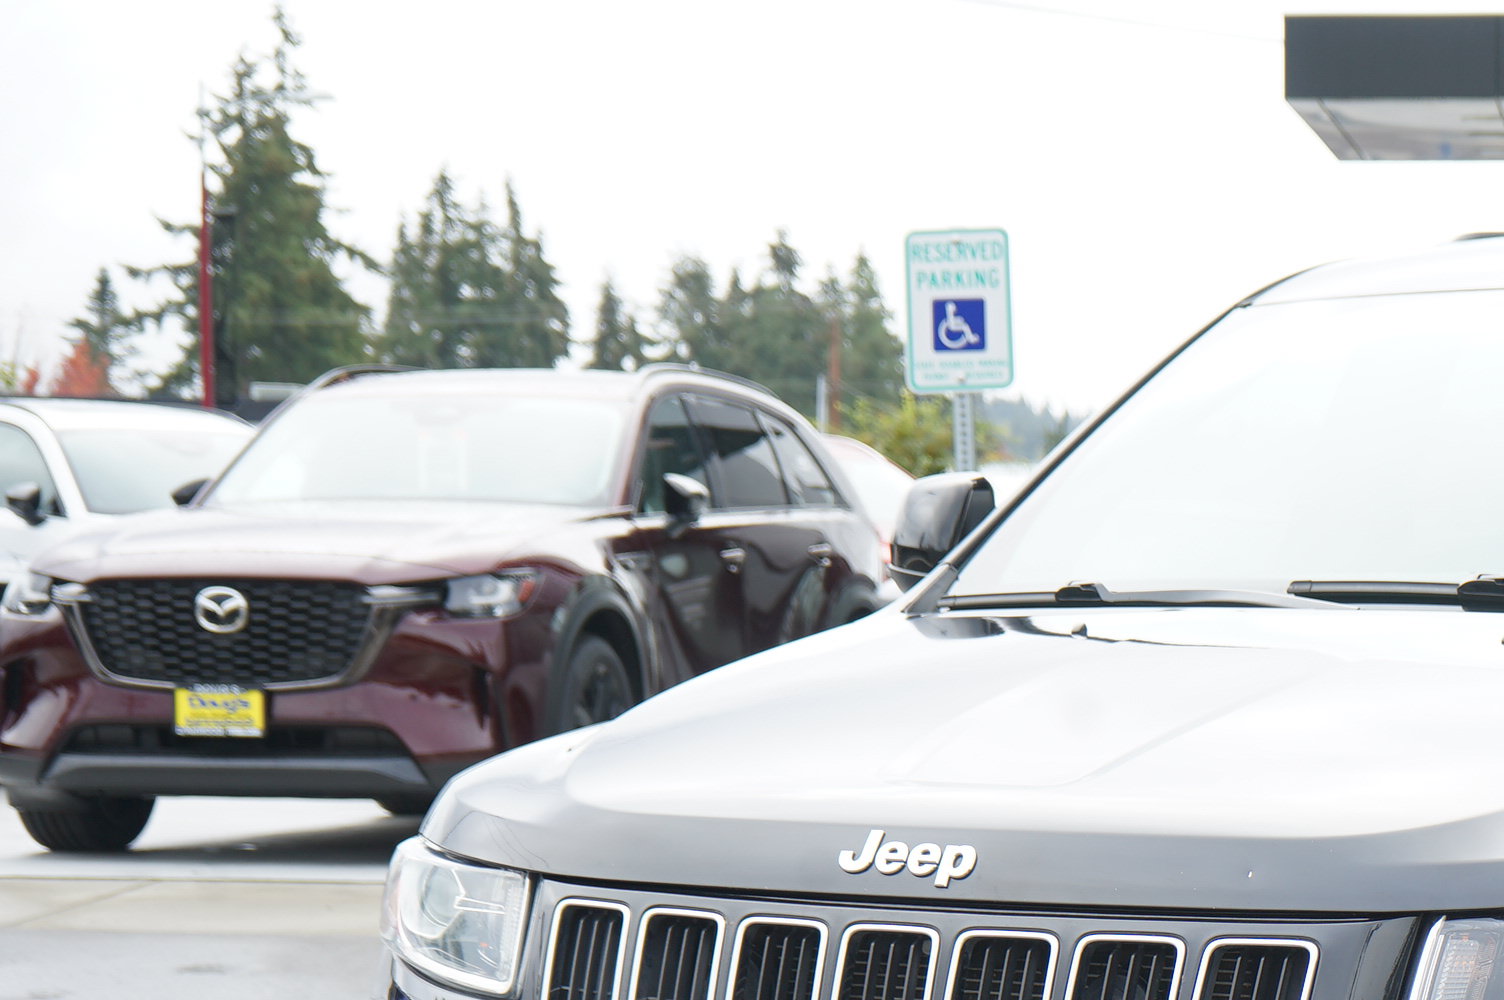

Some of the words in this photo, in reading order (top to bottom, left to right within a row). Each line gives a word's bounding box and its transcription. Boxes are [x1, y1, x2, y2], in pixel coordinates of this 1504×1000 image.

[912, 241, 1003, 262] RESERVED
[917, 267, 1000, 289] PARKING
[838, 829, 977, 888] Jeep
